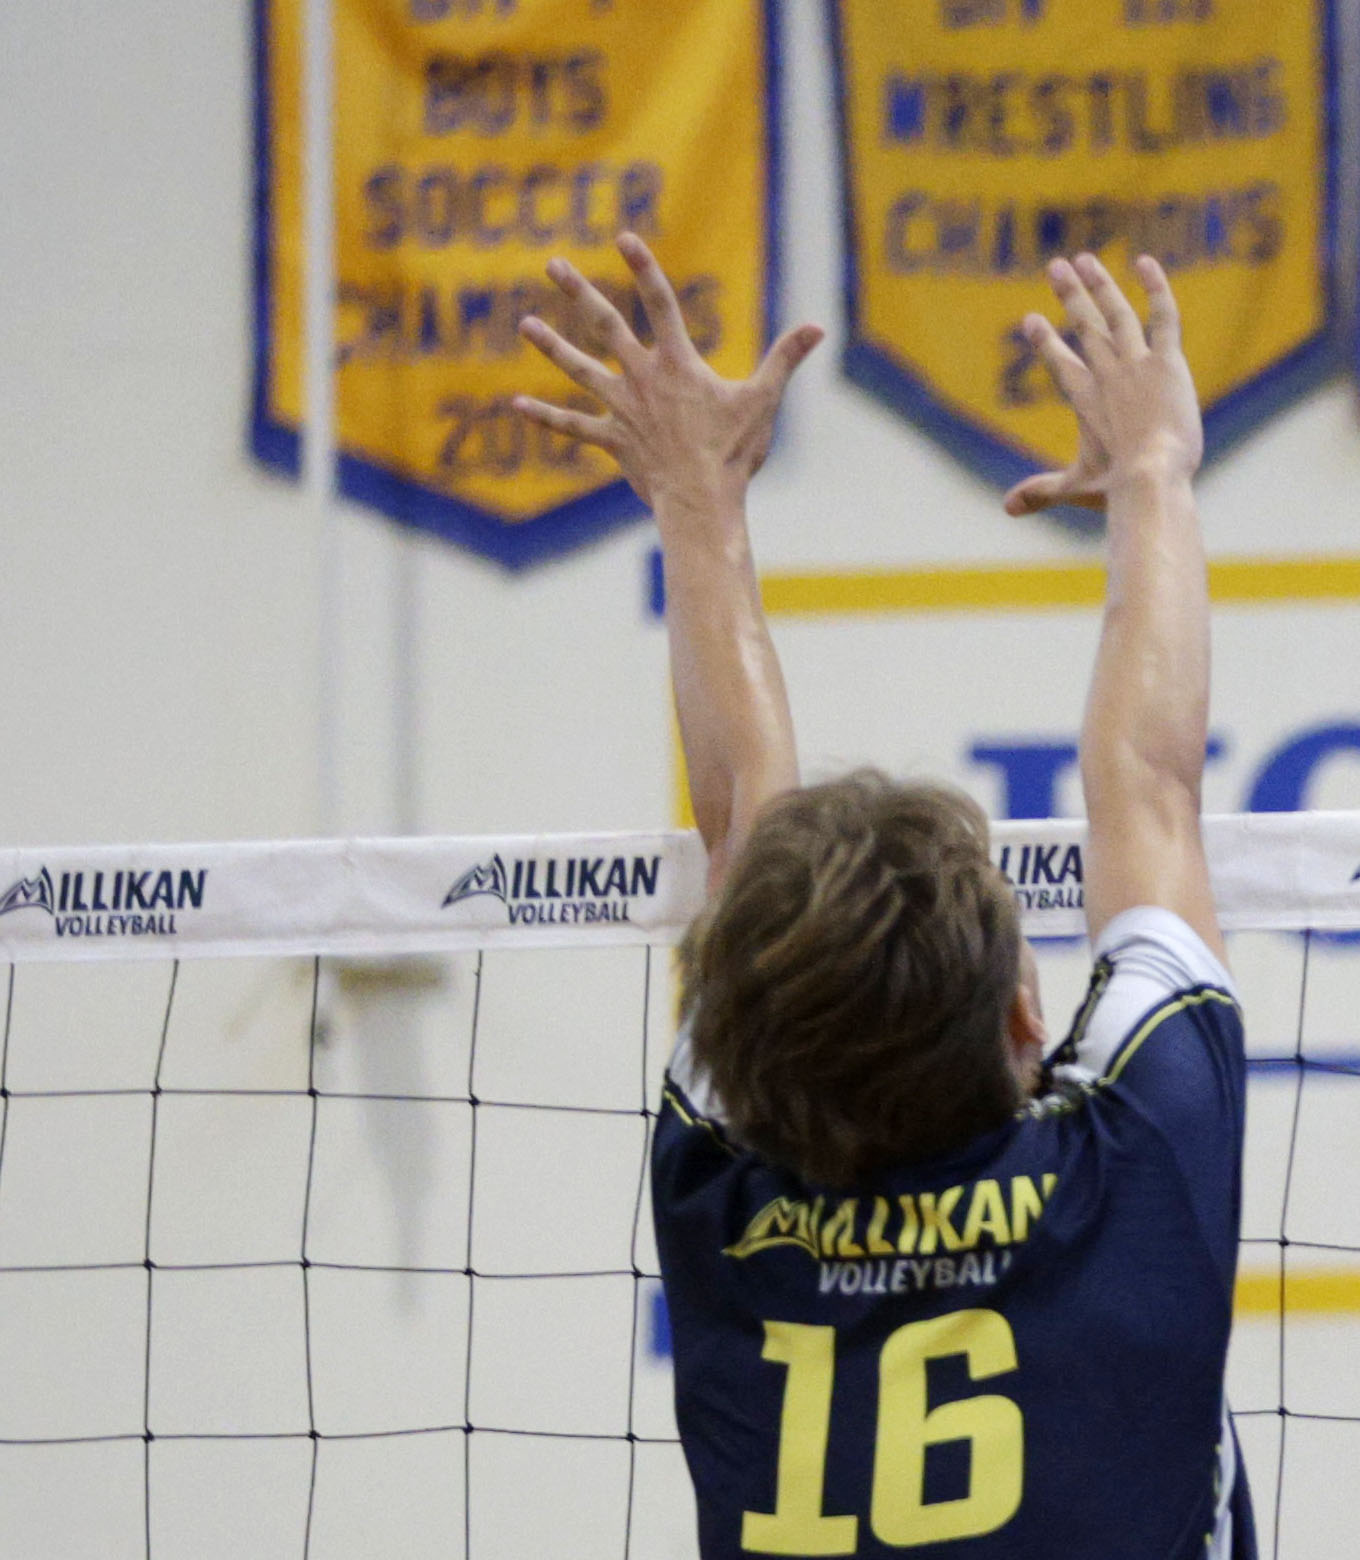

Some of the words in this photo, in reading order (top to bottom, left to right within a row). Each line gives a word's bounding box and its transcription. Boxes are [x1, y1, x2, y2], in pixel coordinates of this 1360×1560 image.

[424, 48, 610, 138] BOYS
[882, 60, 1286, 154] WRESTLING
[364, 160, 666, 250] SOCCER
[55, 910, 178, 938] VOLLEYBALL
[506, 898, 630, 925] VOLLEYBALL
[817, 1250, 1012, 1296] VOLLEYBAL
[740, 1307, 1027, 1558] 16
